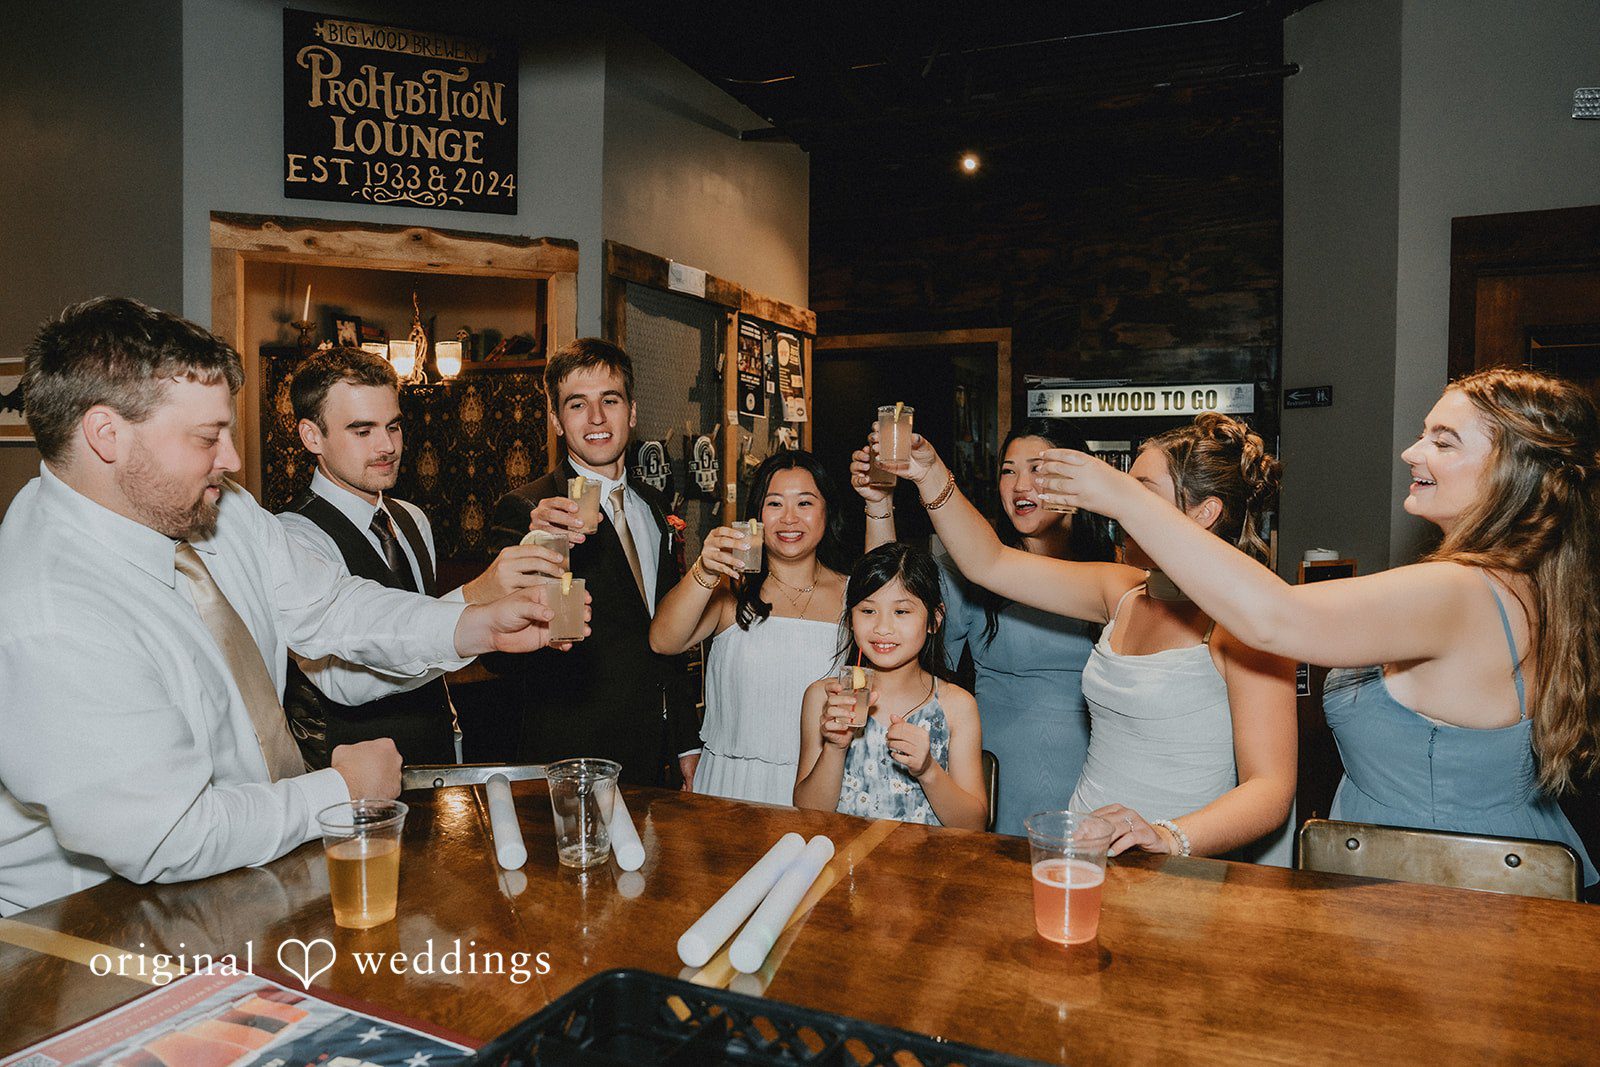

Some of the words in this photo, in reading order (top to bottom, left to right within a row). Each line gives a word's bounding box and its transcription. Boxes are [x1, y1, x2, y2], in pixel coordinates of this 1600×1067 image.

[328, 23, 358, 45] BIG
[361, 27, 408, 51] WOOD
[413, 37, 482, 61] BREWERY
[296, 45, 508, 125] PROHIBITION
[330, 115, 484, 164] LOUNGE
[286, 153, 354, 185] EST
[363, 161, 421, 189] 1933
[428, 165, 447, 191] &
[453, 168, 516, 197] 2024
[1061, 393, 1092, 413] BIG
[1097, 391, 1156, 412] WOOD
[1161, 390, 1186, 411] TO
[1191, 389, 1218, 410] GO
